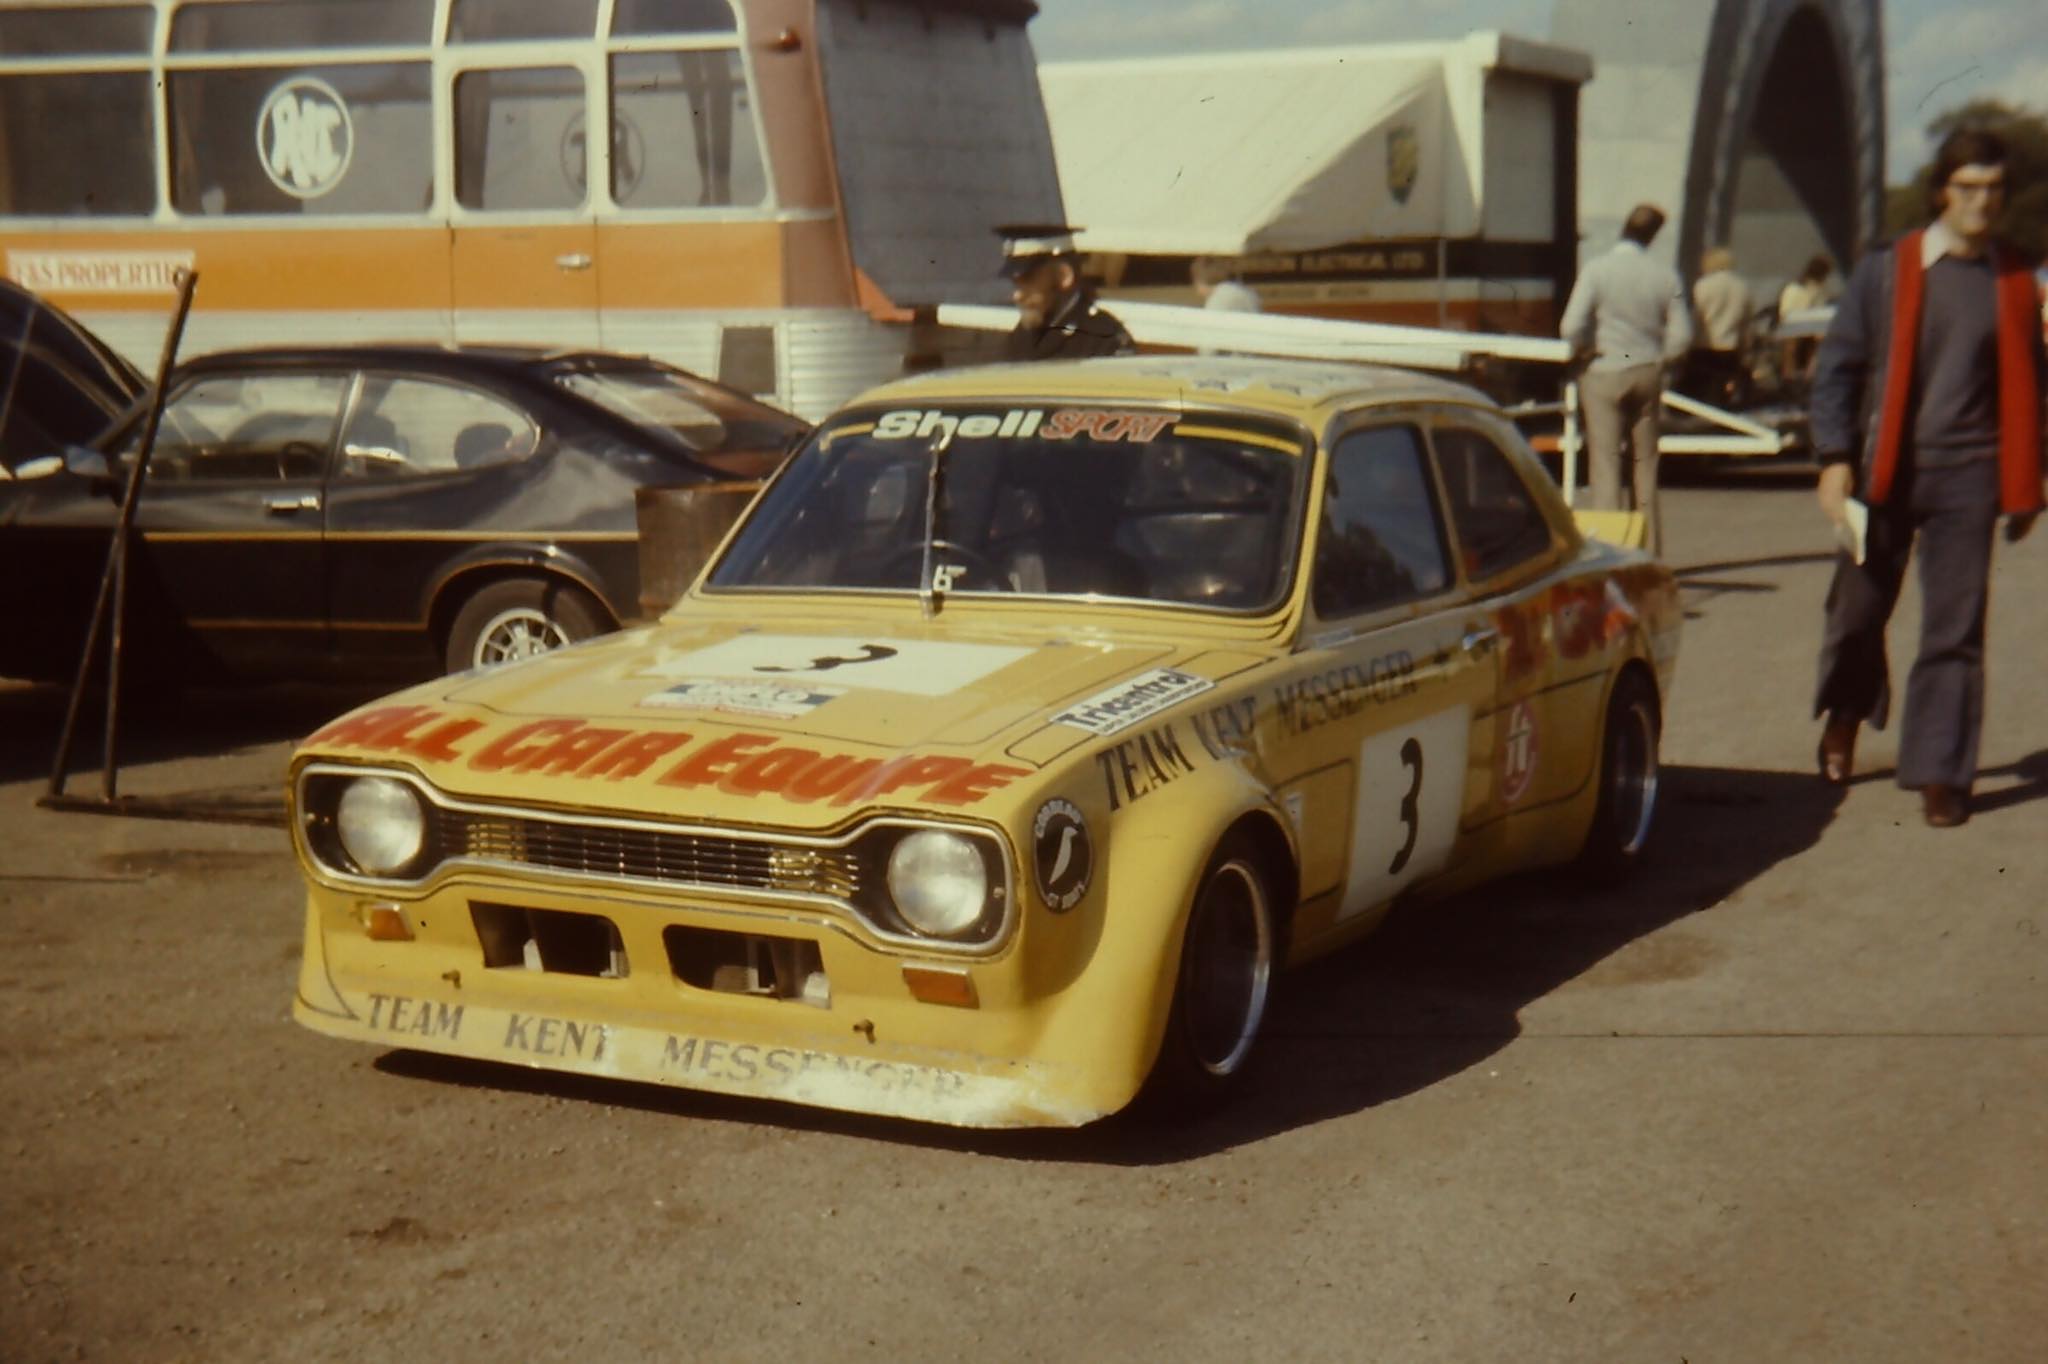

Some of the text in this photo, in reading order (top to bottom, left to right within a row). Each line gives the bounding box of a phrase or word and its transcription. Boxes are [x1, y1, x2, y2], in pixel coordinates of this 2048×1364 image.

[58, 261, 193, 284] PROPERTIE
[871, 410, 1182, 443] Shell SPORT
[303, 703, 1037, 808] ALL CAR EQUIPE
[1094, 722, 1196, 812] TEAM
[1388, 736, 1424, 875] 3
[368, 994, 465, 1040] TEAM
[504, 1012, 608, 1062] KENT
